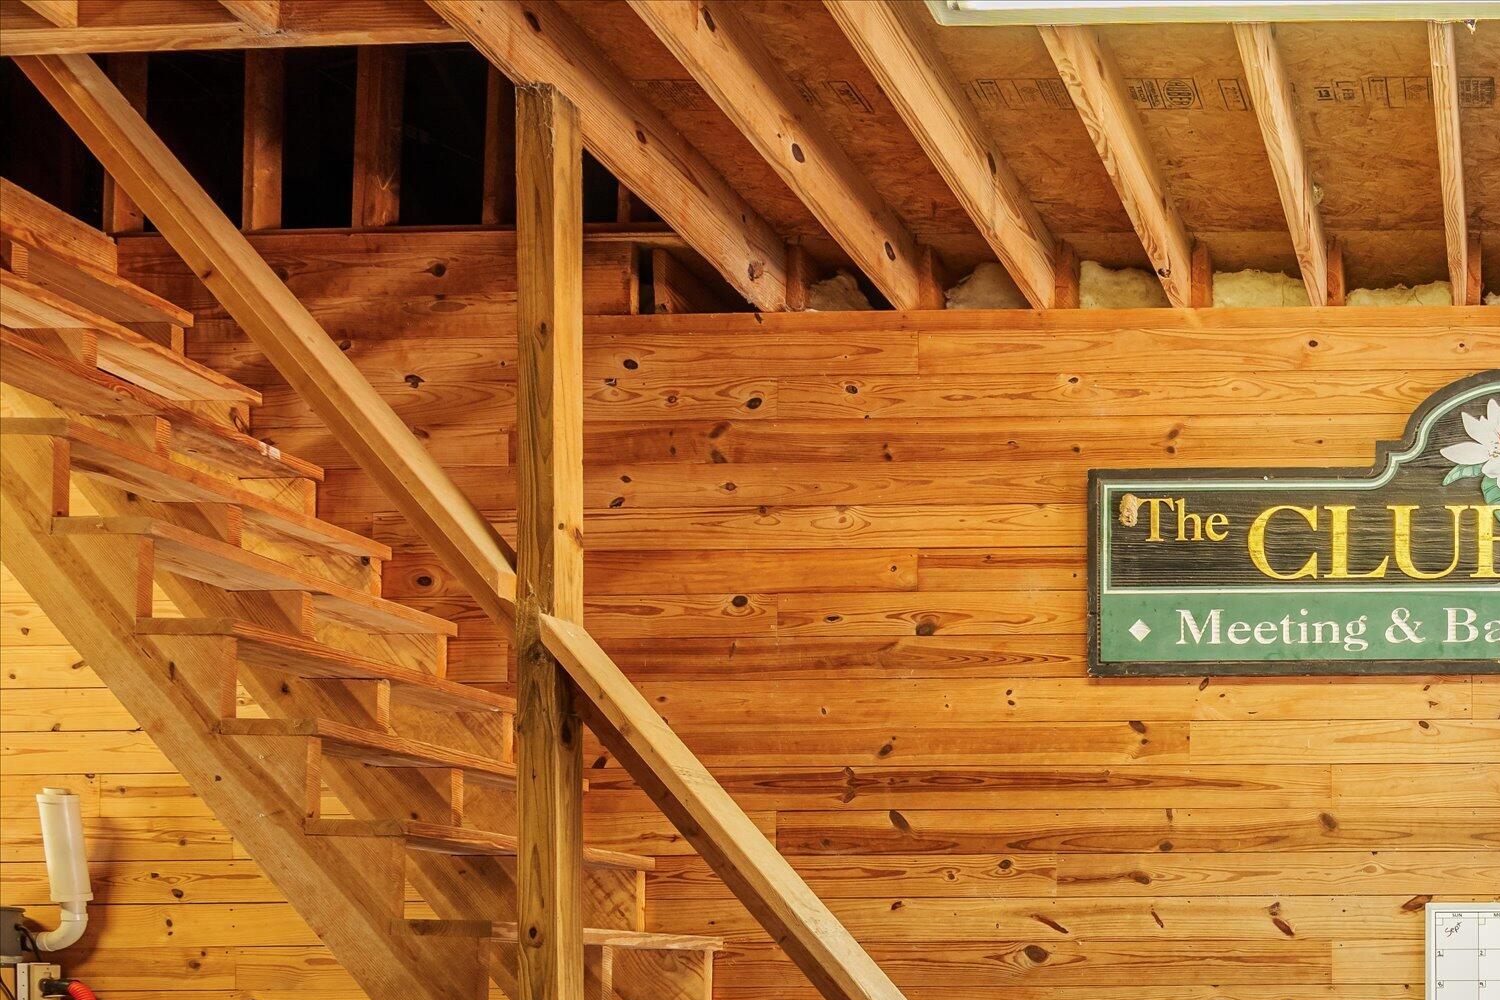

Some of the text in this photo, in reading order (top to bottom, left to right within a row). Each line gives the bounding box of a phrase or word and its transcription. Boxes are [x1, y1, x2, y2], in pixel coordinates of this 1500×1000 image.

[1136, 496, 1229, 542] The
[1175, 608, 1369, 652] Meeting
[1384, 607, 1427, 644] &
[1444, 921, 1463, 938] Sept
